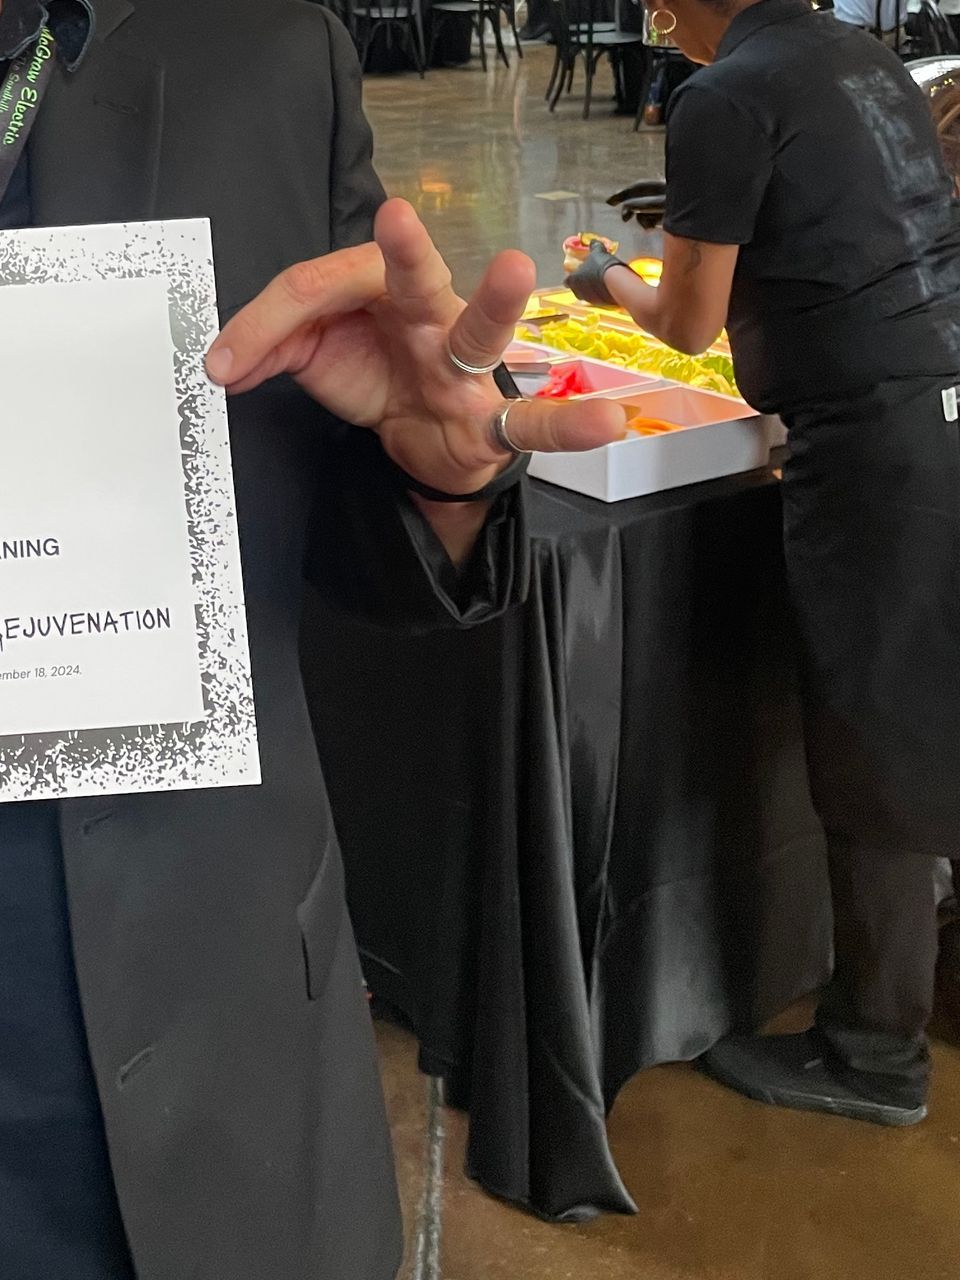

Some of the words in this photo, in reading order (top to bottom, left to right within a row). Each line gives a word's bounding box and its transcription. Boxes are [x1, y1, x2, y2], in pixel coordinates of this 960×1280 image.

[27, 26, 55, 84] McGraw
[3, 87, 38, 145] Electric
[35, 666, 48, 679] 18,
[51, 664, 82, 678] 2024.
